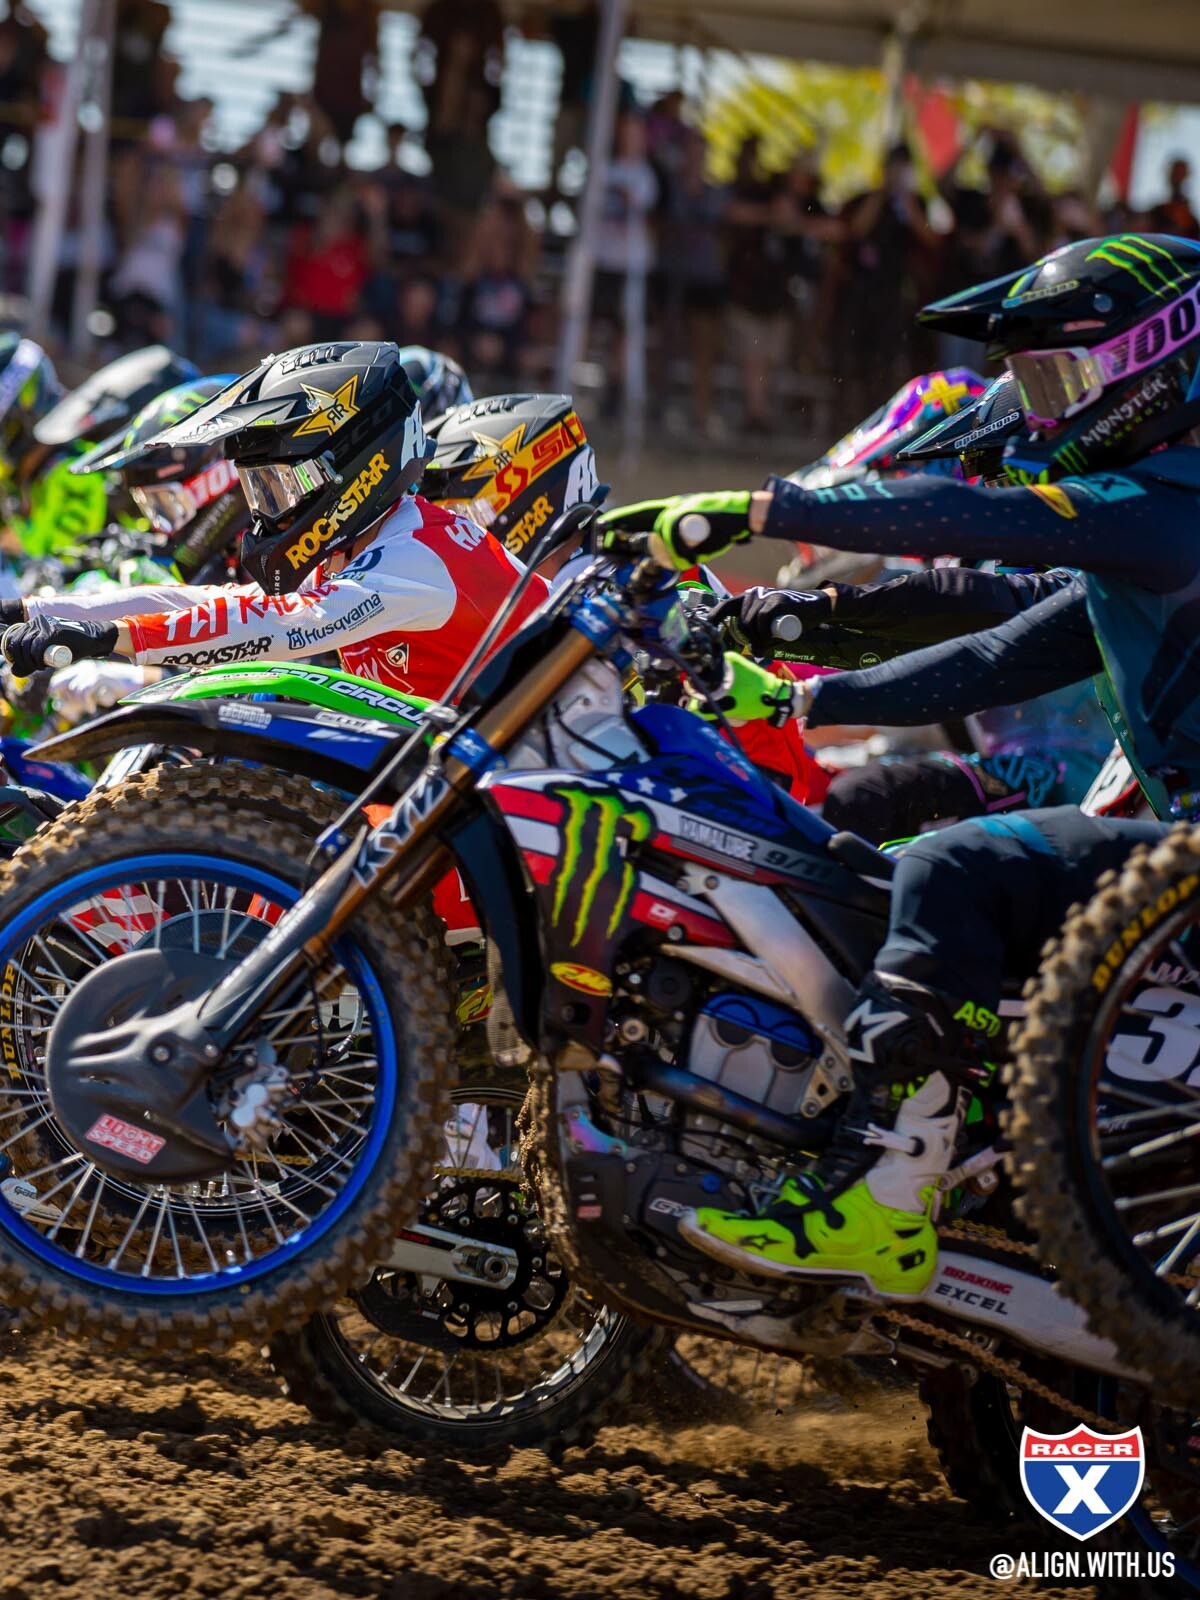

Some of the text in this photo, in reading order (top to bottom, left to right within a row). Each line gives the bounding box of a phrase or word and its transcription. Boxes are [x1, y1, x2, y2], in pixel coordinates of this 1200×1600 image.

[954, 411, 1019, 449] apdesigns
[1080, 374, 1168, 447] MONSTER
[285, 451, 391, 570] ROCKSTAR
[305, 592, 383, 644] Husqvarna
[161, 638, 271, 665] ROCKSTAR
[328, 680, 426, 726] CIRCU
[0, 963, 22, 1080] DUNLOP
[935, 1282, 1008, 1315] EXCEL
[943, 1266, 1013, 1295] BRAKING
